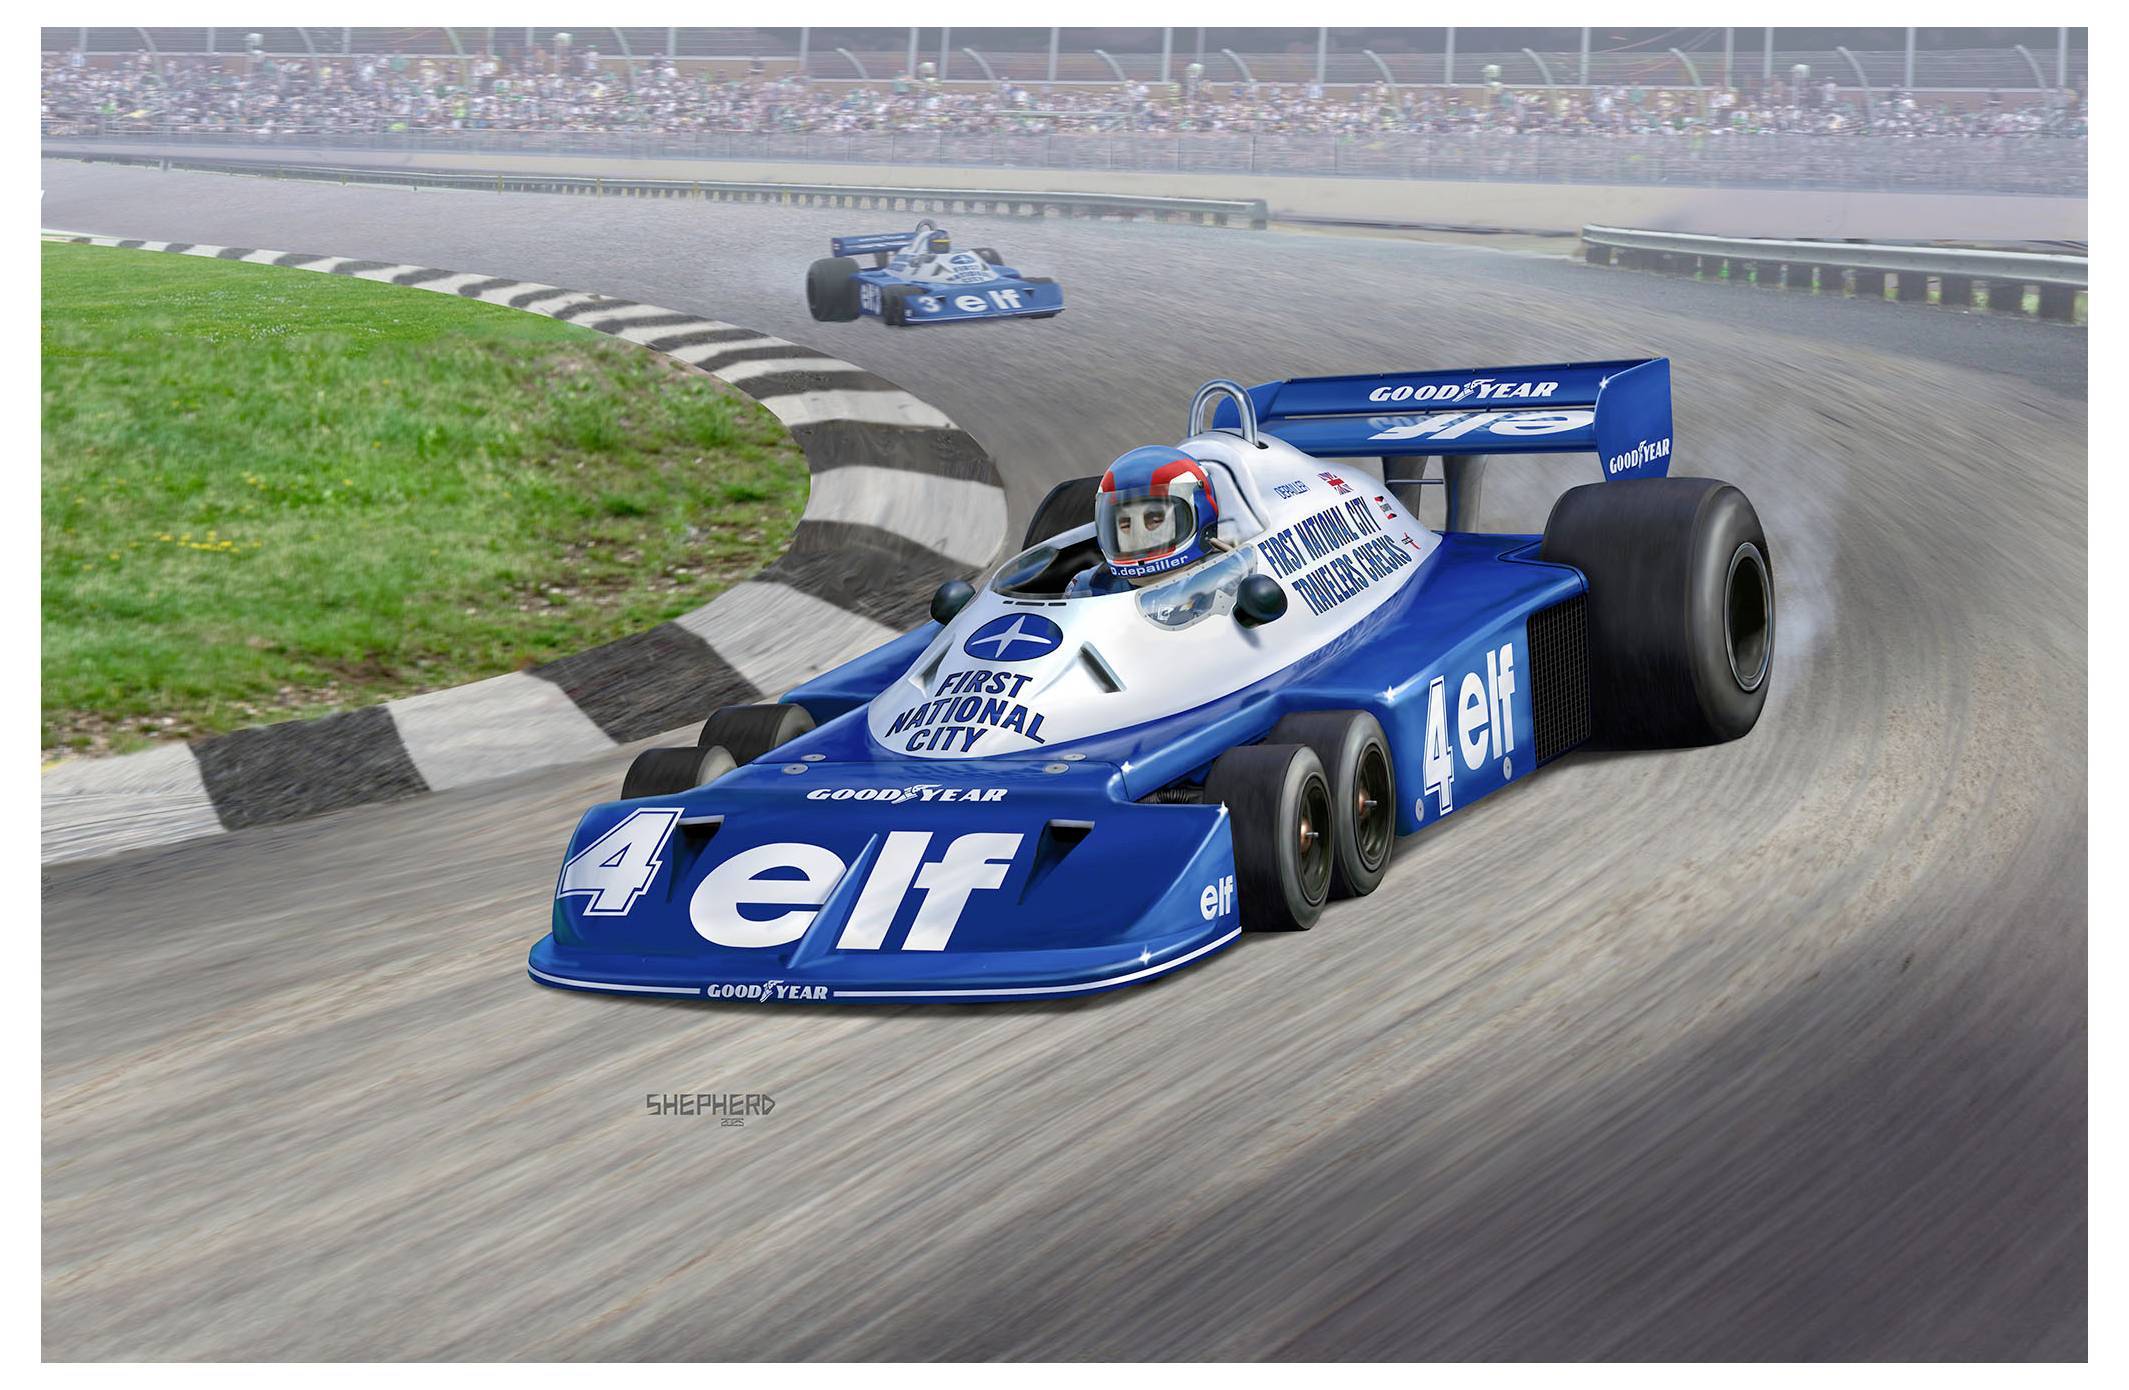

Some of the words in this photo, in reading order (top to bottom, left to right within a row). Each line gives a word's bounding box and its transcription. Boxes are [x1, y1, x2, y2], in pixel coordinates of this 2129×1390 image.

[918, 296, 942, 313] 3
[955, 289, 1023, 313] elf
[1257, 528, 1307, 579] FIRST
[1293, 505, 1360, 561] NATIONAL
[1344, 496, 1382, 536] CITY
[1291, 554, 1369, 616] TRAVELERS
[1352, 534, 1412, 582] CHECKS
[935, 670, 1033, 699] FIRST
[885, 696, 1047, 744] NATIONAL
[905, 726, 988, 753] CITY
[1422, 675, 1455, 816] 4
[1457, 643, 1515, 770] elf
[556, 807, 686, 917] 4
[689, 831, 1025, 951] elf
[1200, 874, 1234, 920] elf
